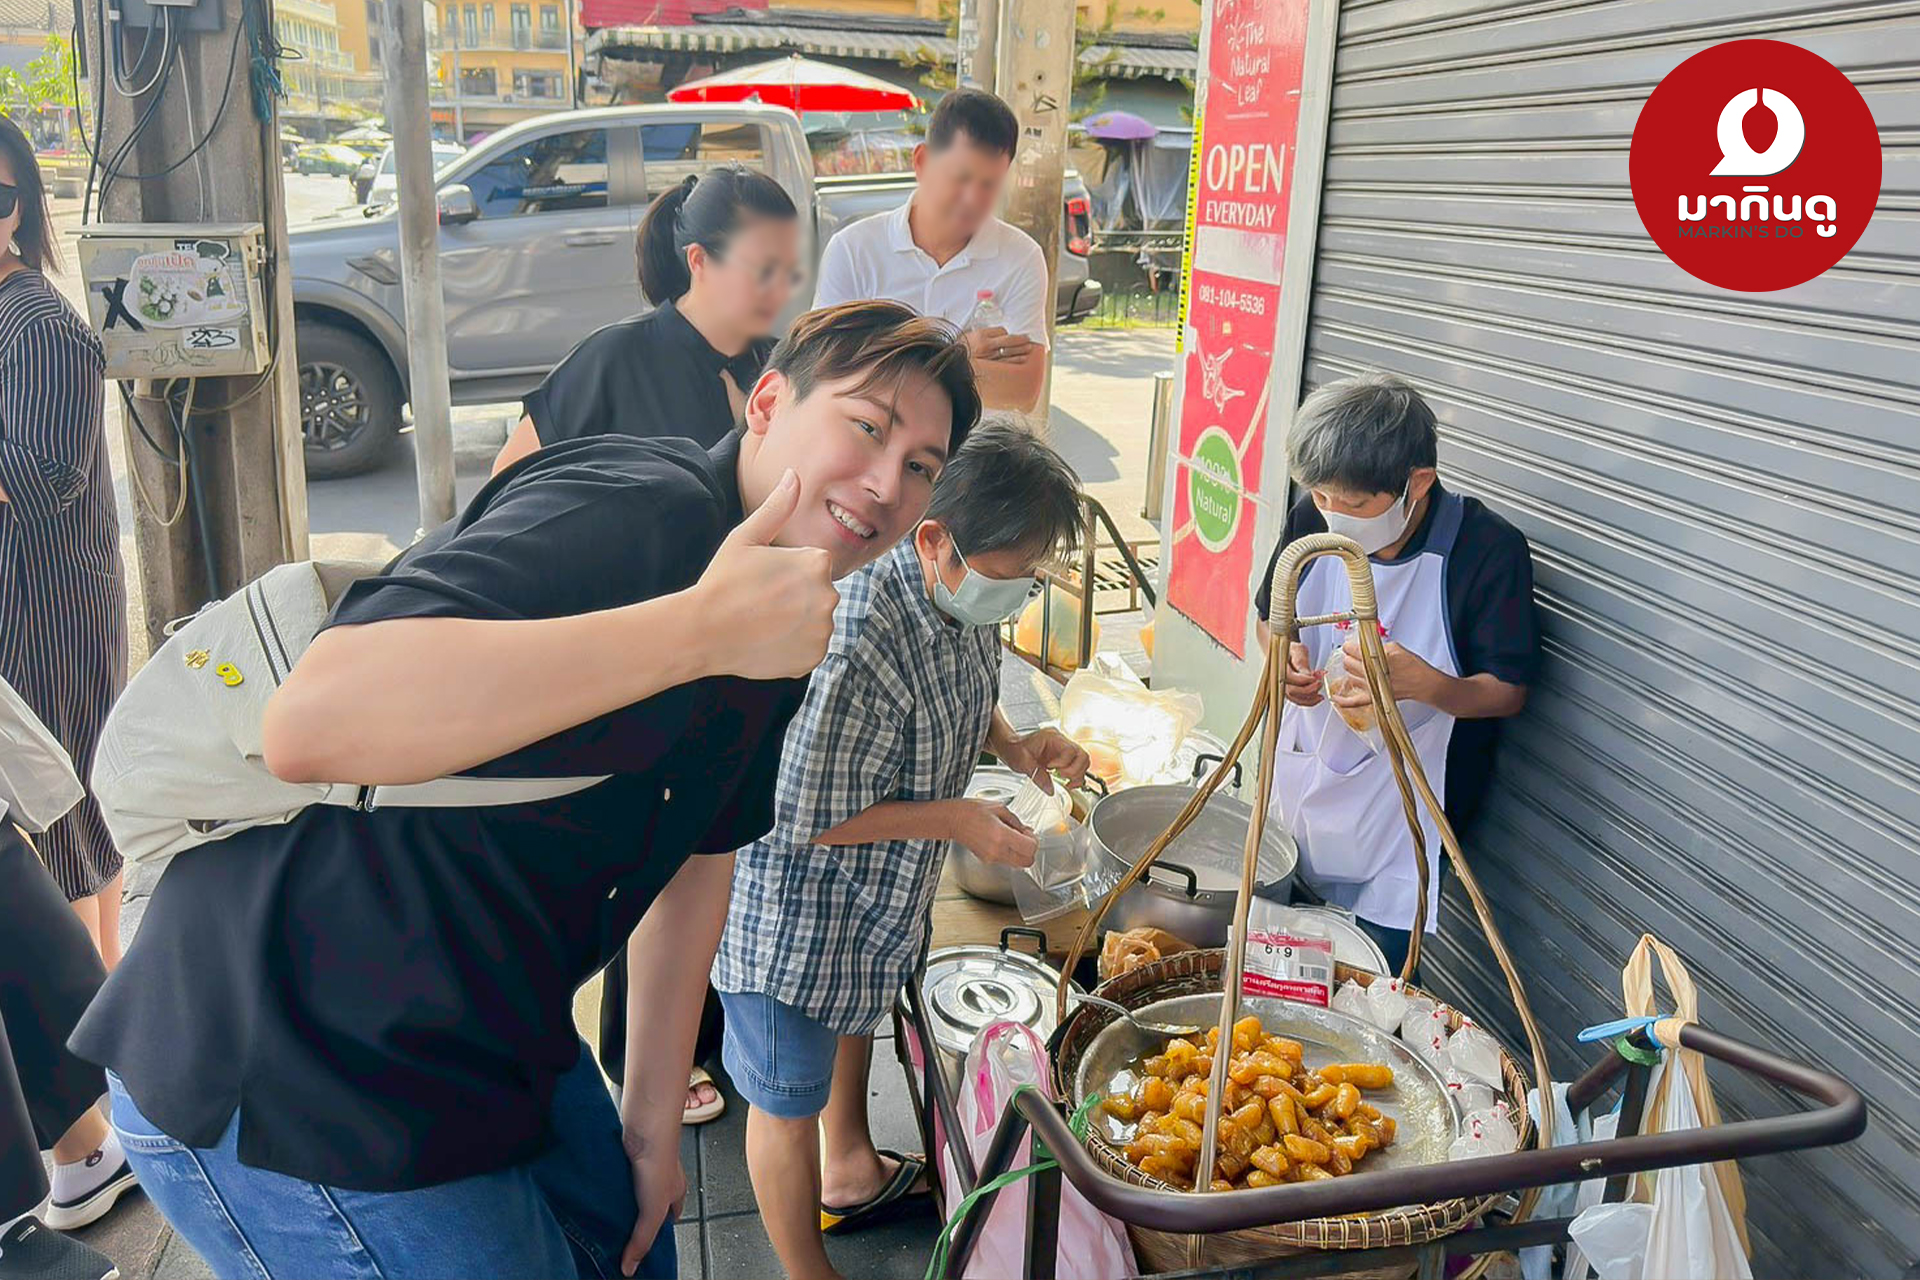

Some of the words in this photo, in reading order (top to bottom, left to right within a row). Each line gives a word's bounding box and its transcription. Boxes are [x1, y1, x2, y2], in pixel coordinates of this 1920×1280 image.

[1244, 21, 1265, 48] The
[1231, 48, 1271, 78] Natural
[1238, 78, 1263, 107] Leaf
[1206, 143, 1285, 194] OPEN
[1206, 200, 1276, 228] EVERYDAY
[1195, 487, 1232, 525] Natural
